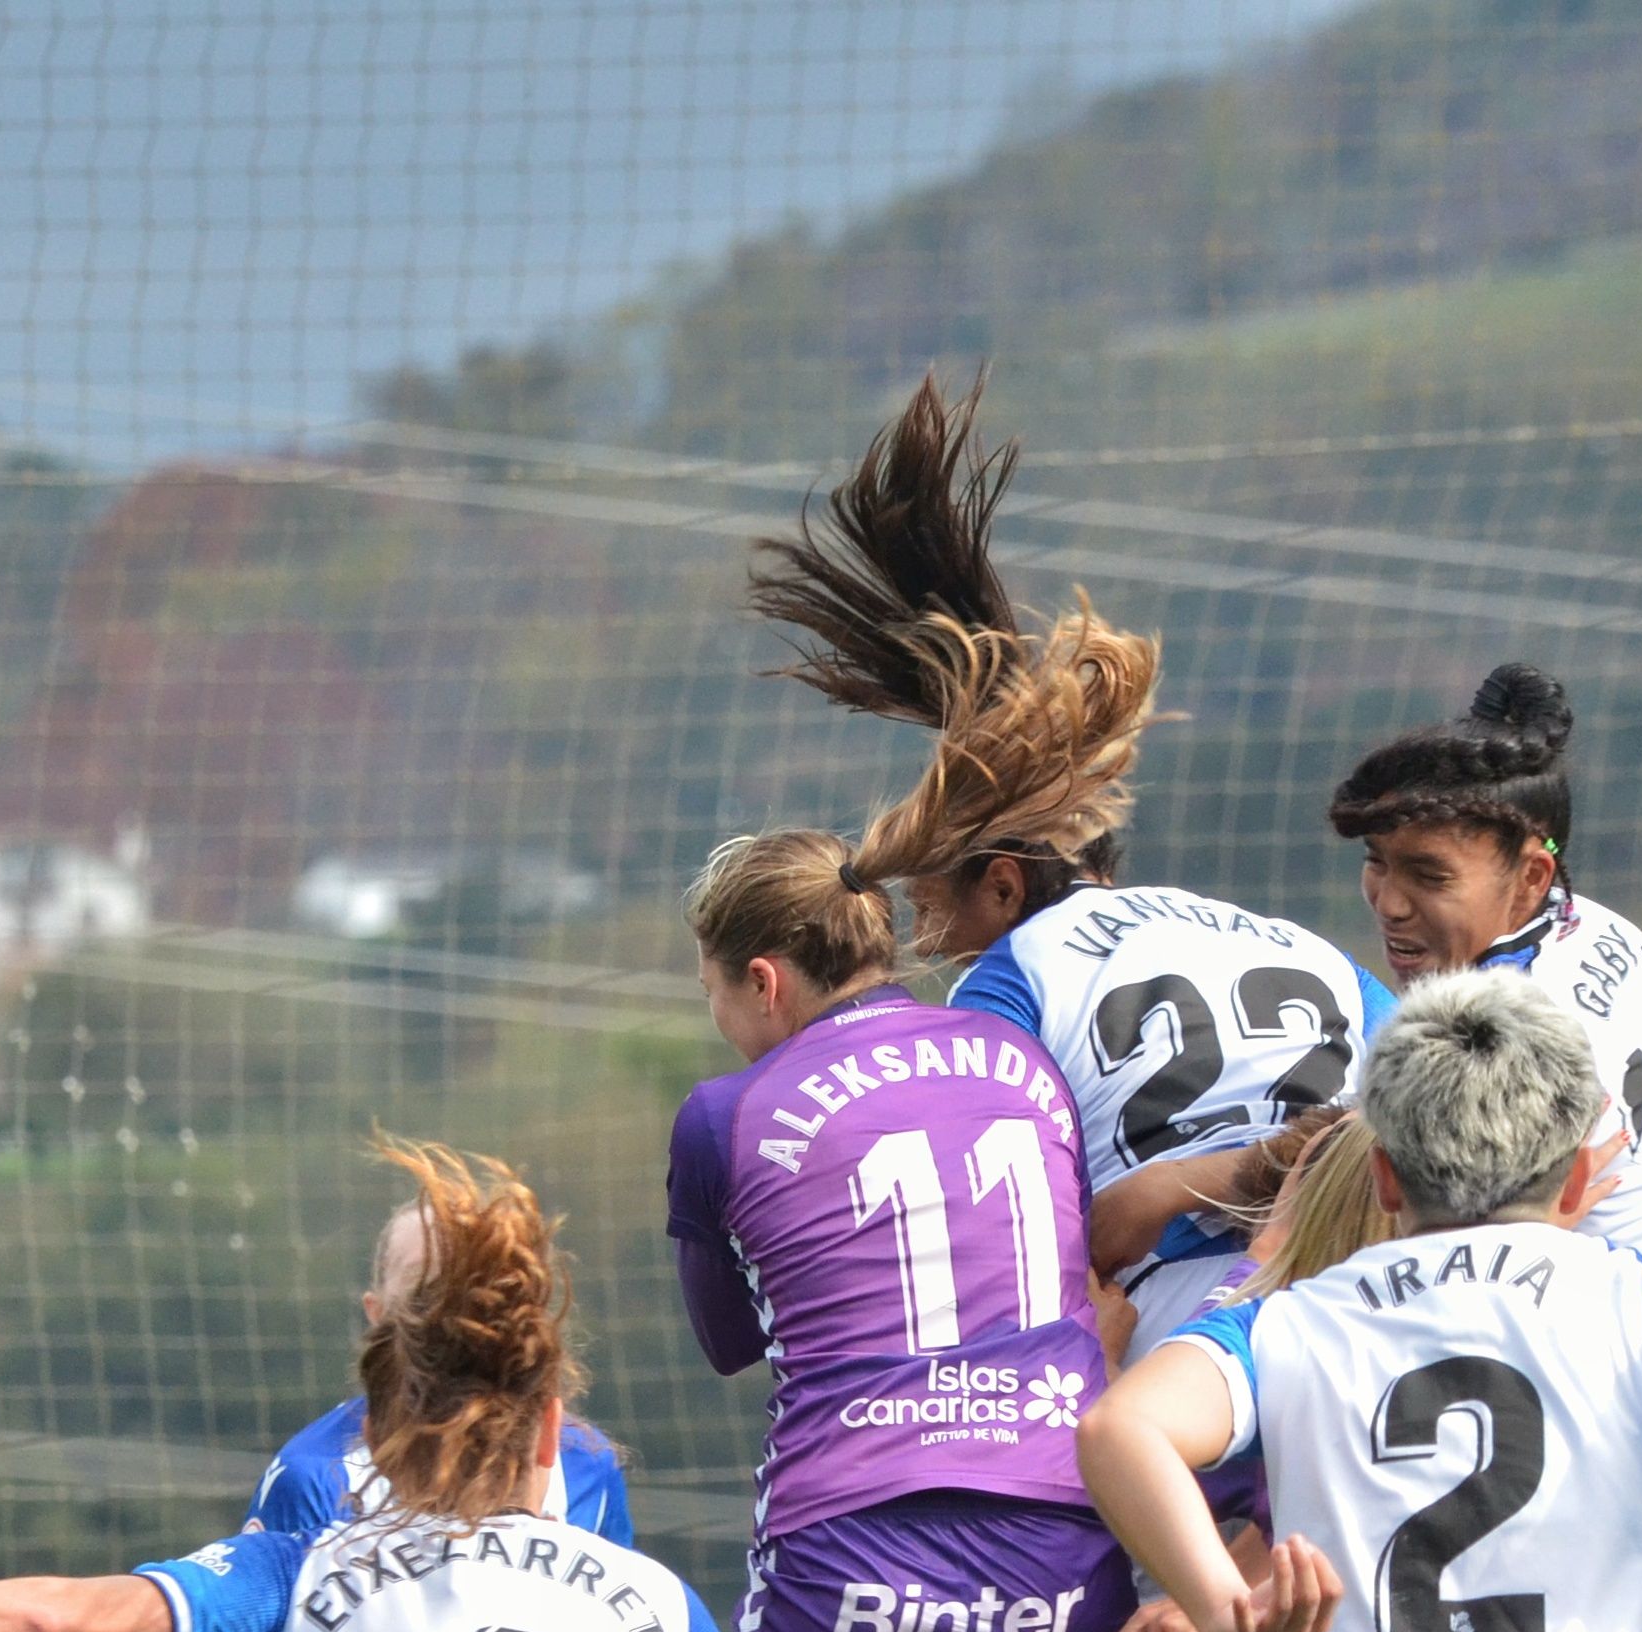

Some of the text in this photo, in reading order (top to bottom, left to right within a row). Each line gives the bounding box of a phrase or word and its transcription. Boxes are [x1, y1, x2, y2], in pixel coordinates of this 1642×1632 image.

[758, 1037, 1075, 1174] ALEKSANDRA
[1089, 966, 1353, 1169] 22
[847, 1118, 1061, 1355] 11
[1355, 1244, 1555, 1312] IRAIA
[928, 1359, 1019, 1393] Islas
[973, 1428, 990, 1440] DE
[992, 1427, 1019, 1445] VIDA
